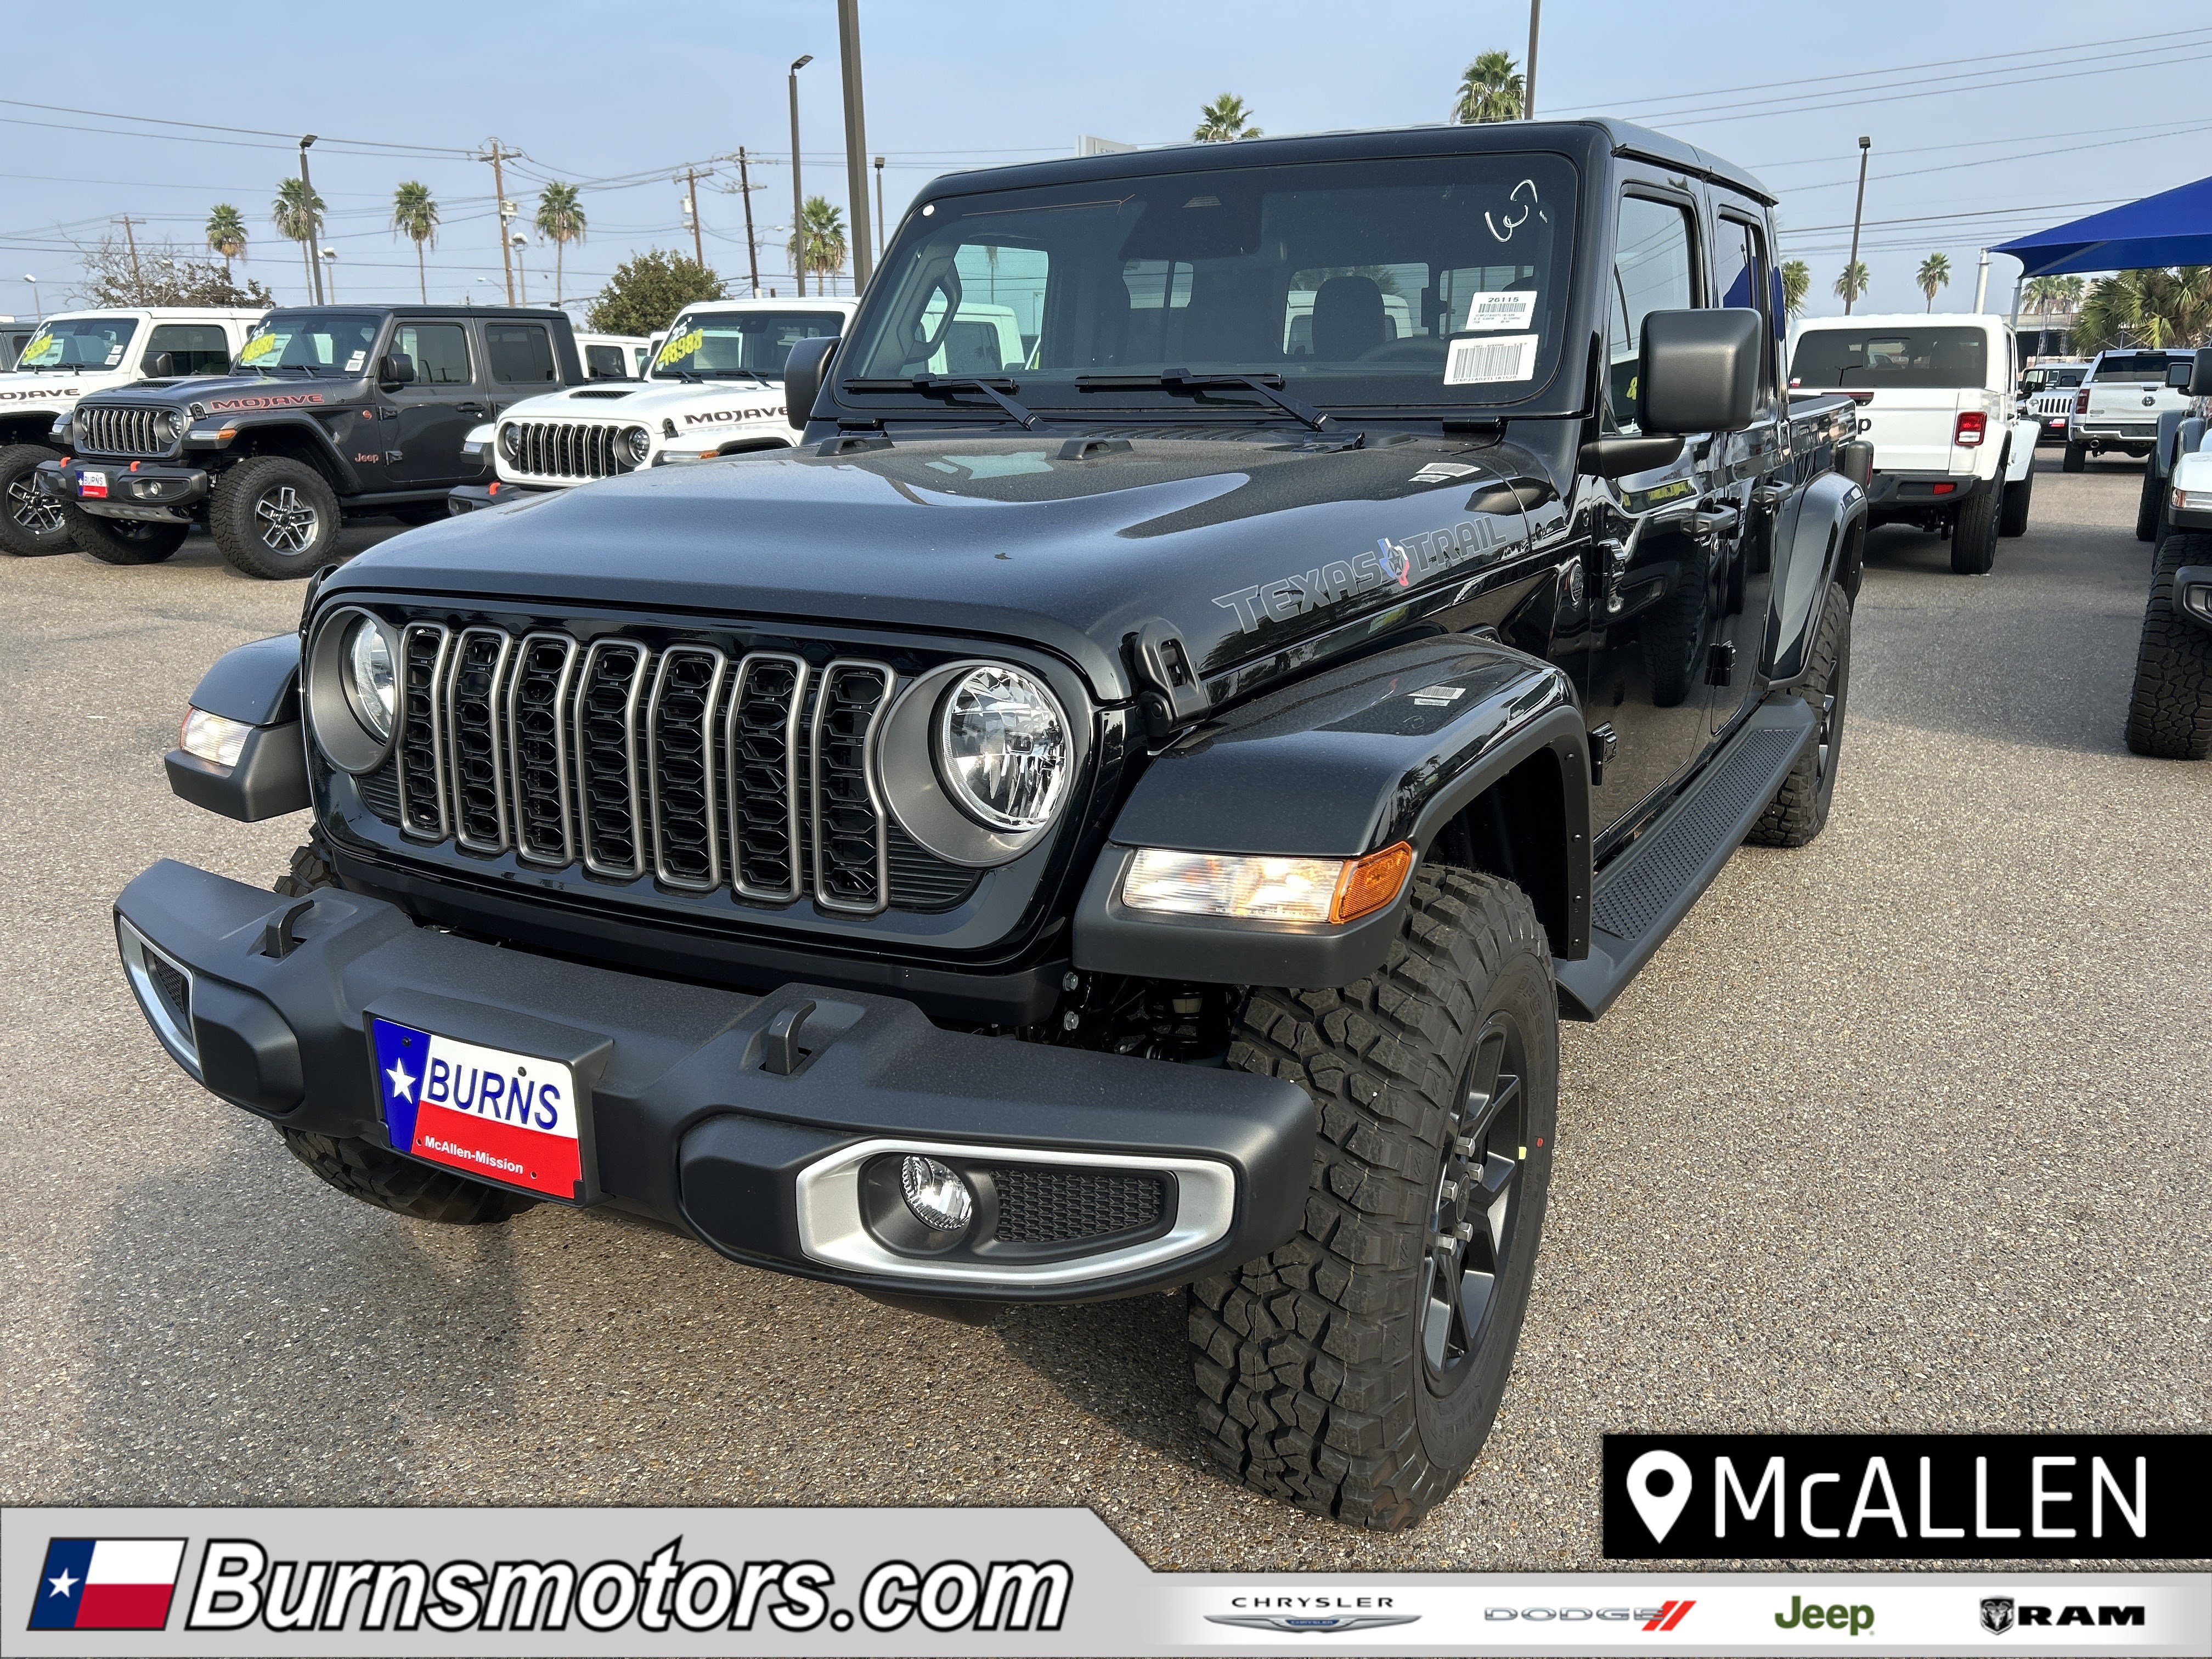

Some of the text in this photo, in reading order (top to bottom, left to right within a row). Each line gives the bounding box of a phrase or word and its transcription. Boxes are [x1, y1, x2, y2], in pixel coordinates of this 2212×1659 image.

[0, 388, 81, 401] OJAVE
[211, 393, 325, 410] MOJAVE
[354, 453, 380, 464] Jeep
[84, 475, 104, 486] BURNS
[1212, 516, 1507, 635] TEXAS TRAIL
[427, 1057, 561, 1131] BURNS
[425, 1135, 523, 1175] McAllen-Mission
